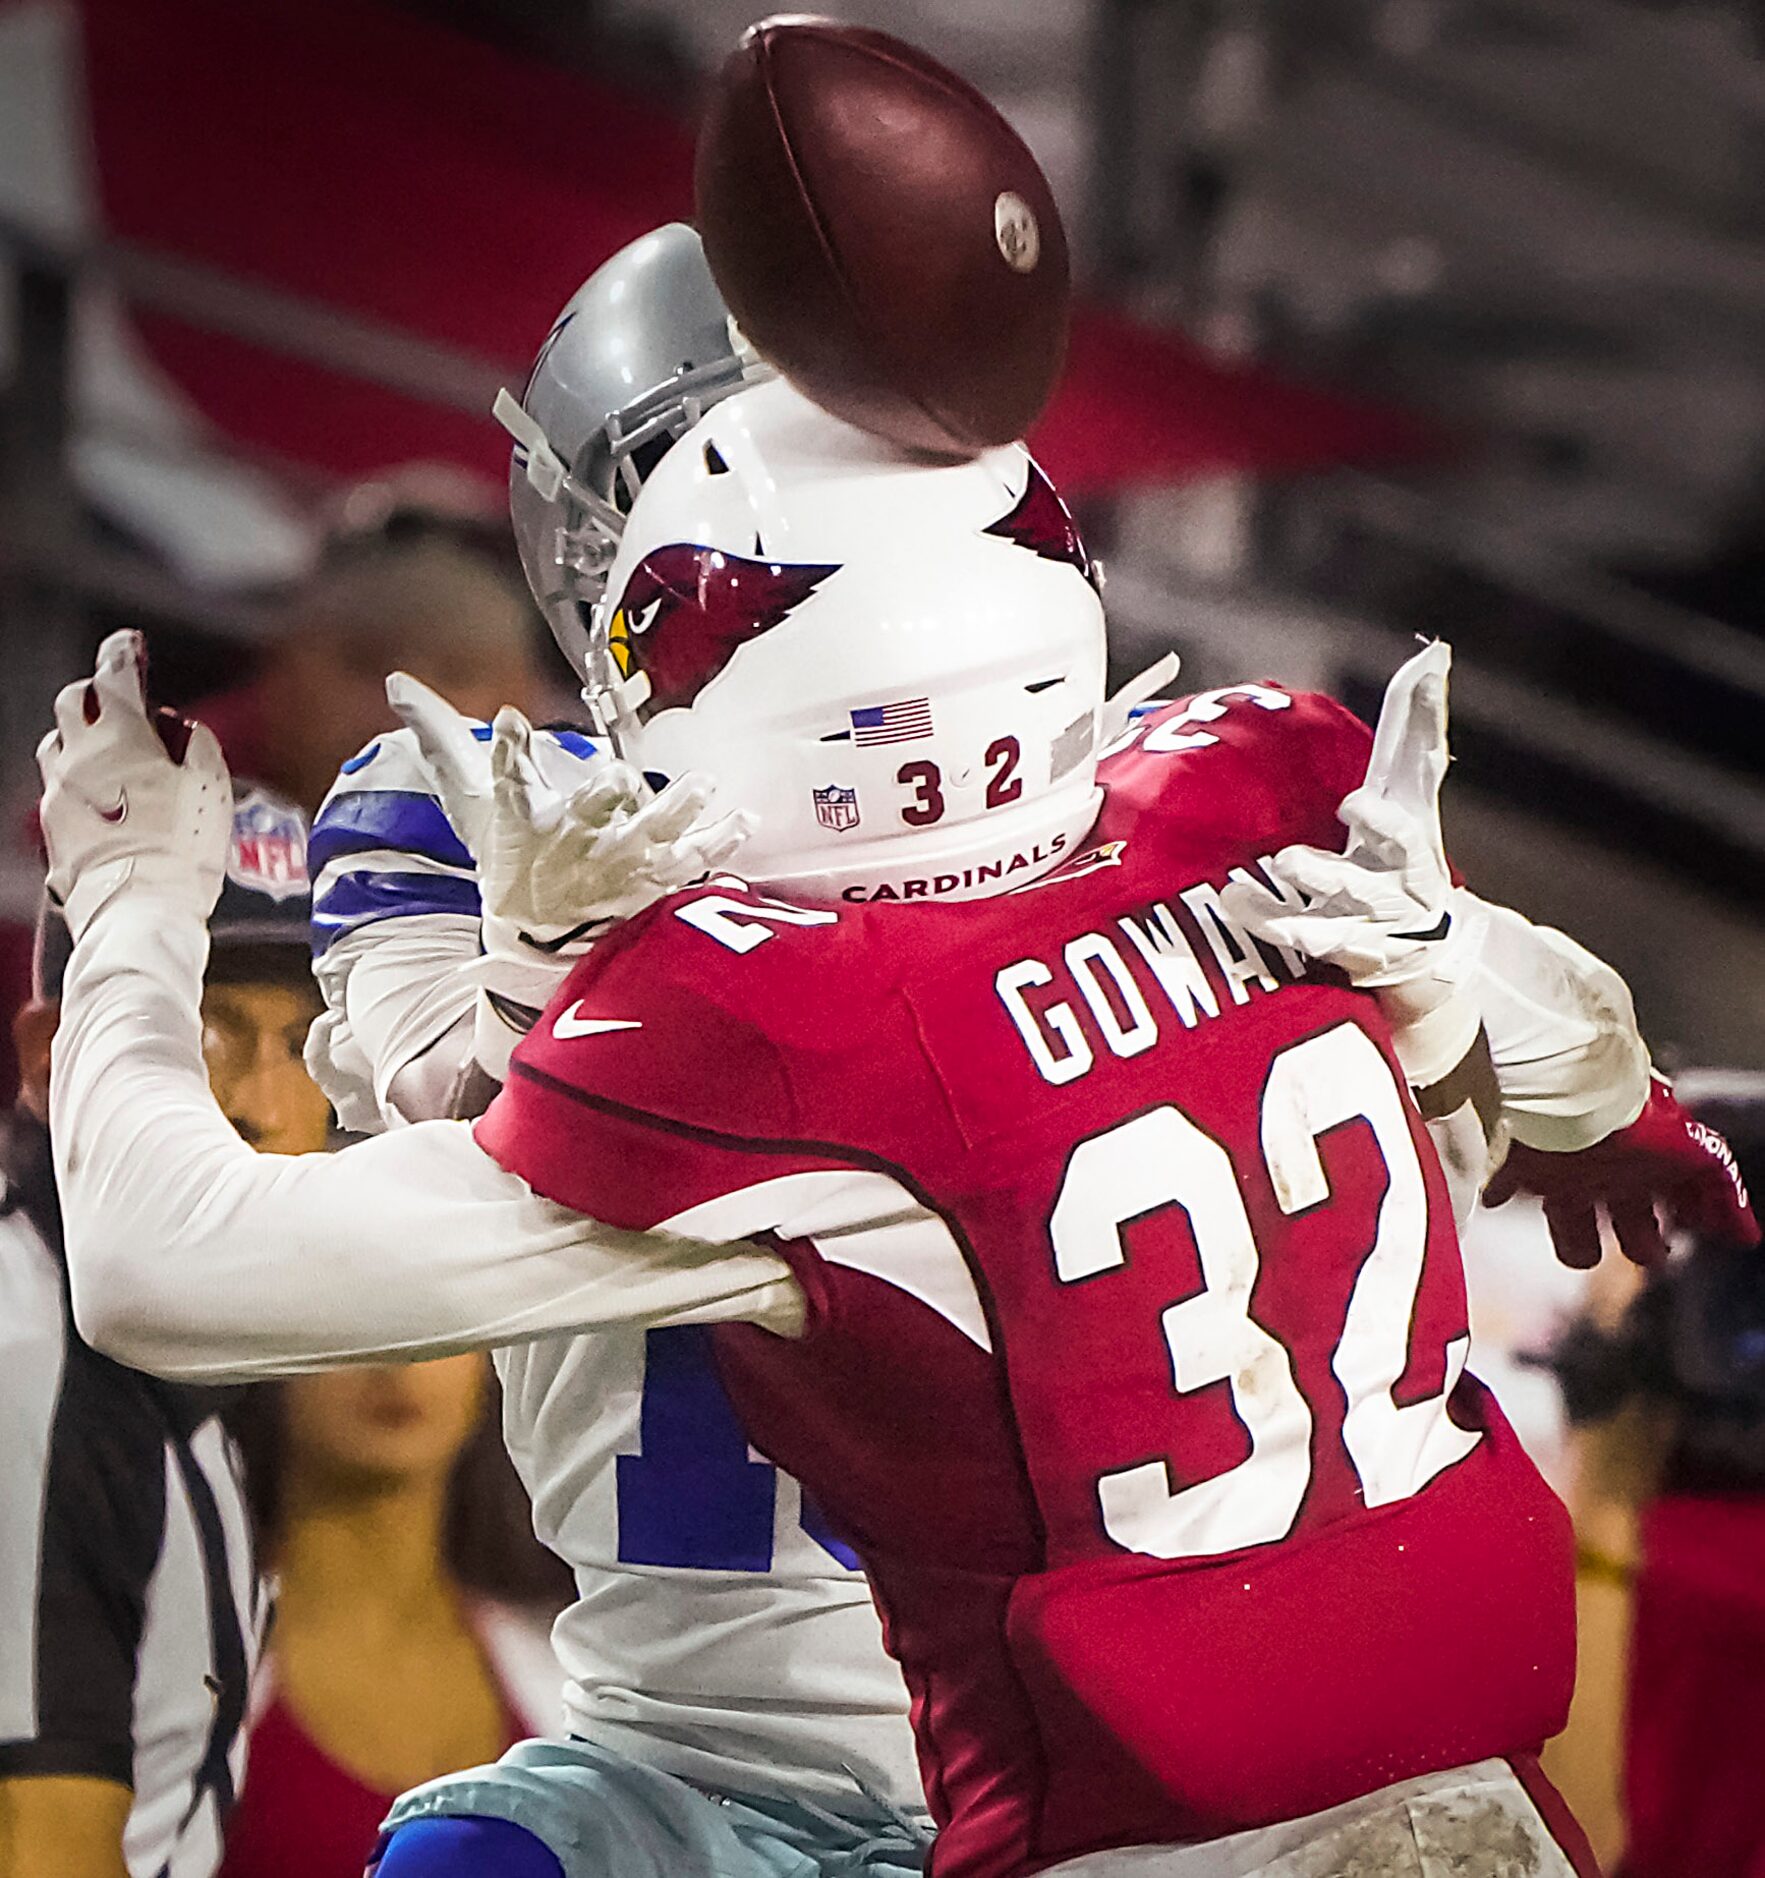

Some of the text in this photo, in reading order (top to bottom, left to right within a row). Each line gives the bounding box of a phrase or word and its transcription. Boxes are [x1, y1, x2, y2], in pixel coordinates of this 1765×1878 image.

[1097, 683, 1292, 762] 3
[819, 804, 858, 828] NFL
[238, 837, 308, 881] NFL
[841, 832, 1067, 903] CARDINALS
[673, 874, 840, 955] 2
[1050, 1020, 1483, 1560] 32
[615, 1320, 870, 1573] 1
